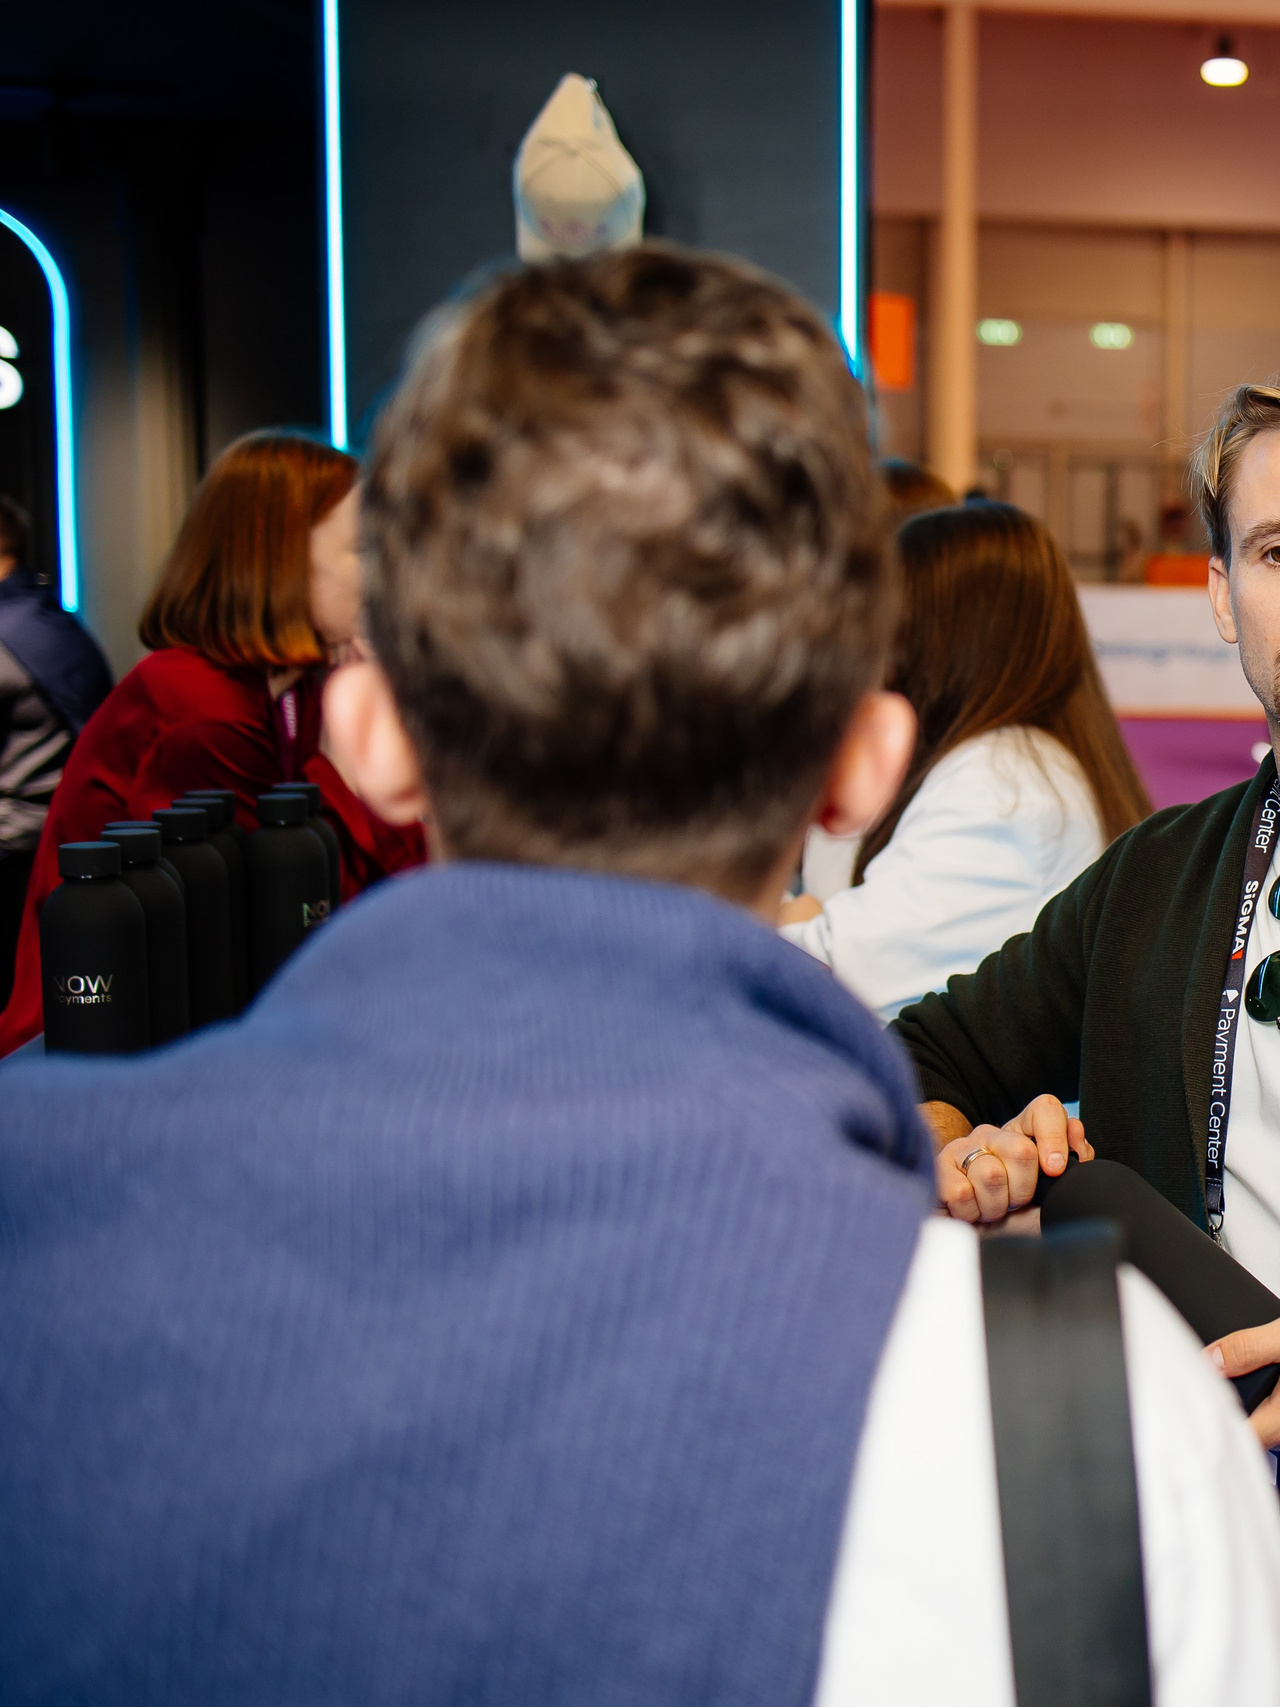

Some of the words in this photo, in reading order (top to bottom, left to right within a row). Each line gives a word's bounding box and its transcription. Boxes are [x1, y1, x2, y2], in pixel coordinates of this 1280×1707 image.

[303, 899, 331, 919] NO
[52, 974, 113, 994] NOW
[1211, 1008, 1236, 1096] Payment
[1207, 1100, 1226, 1168] Center
